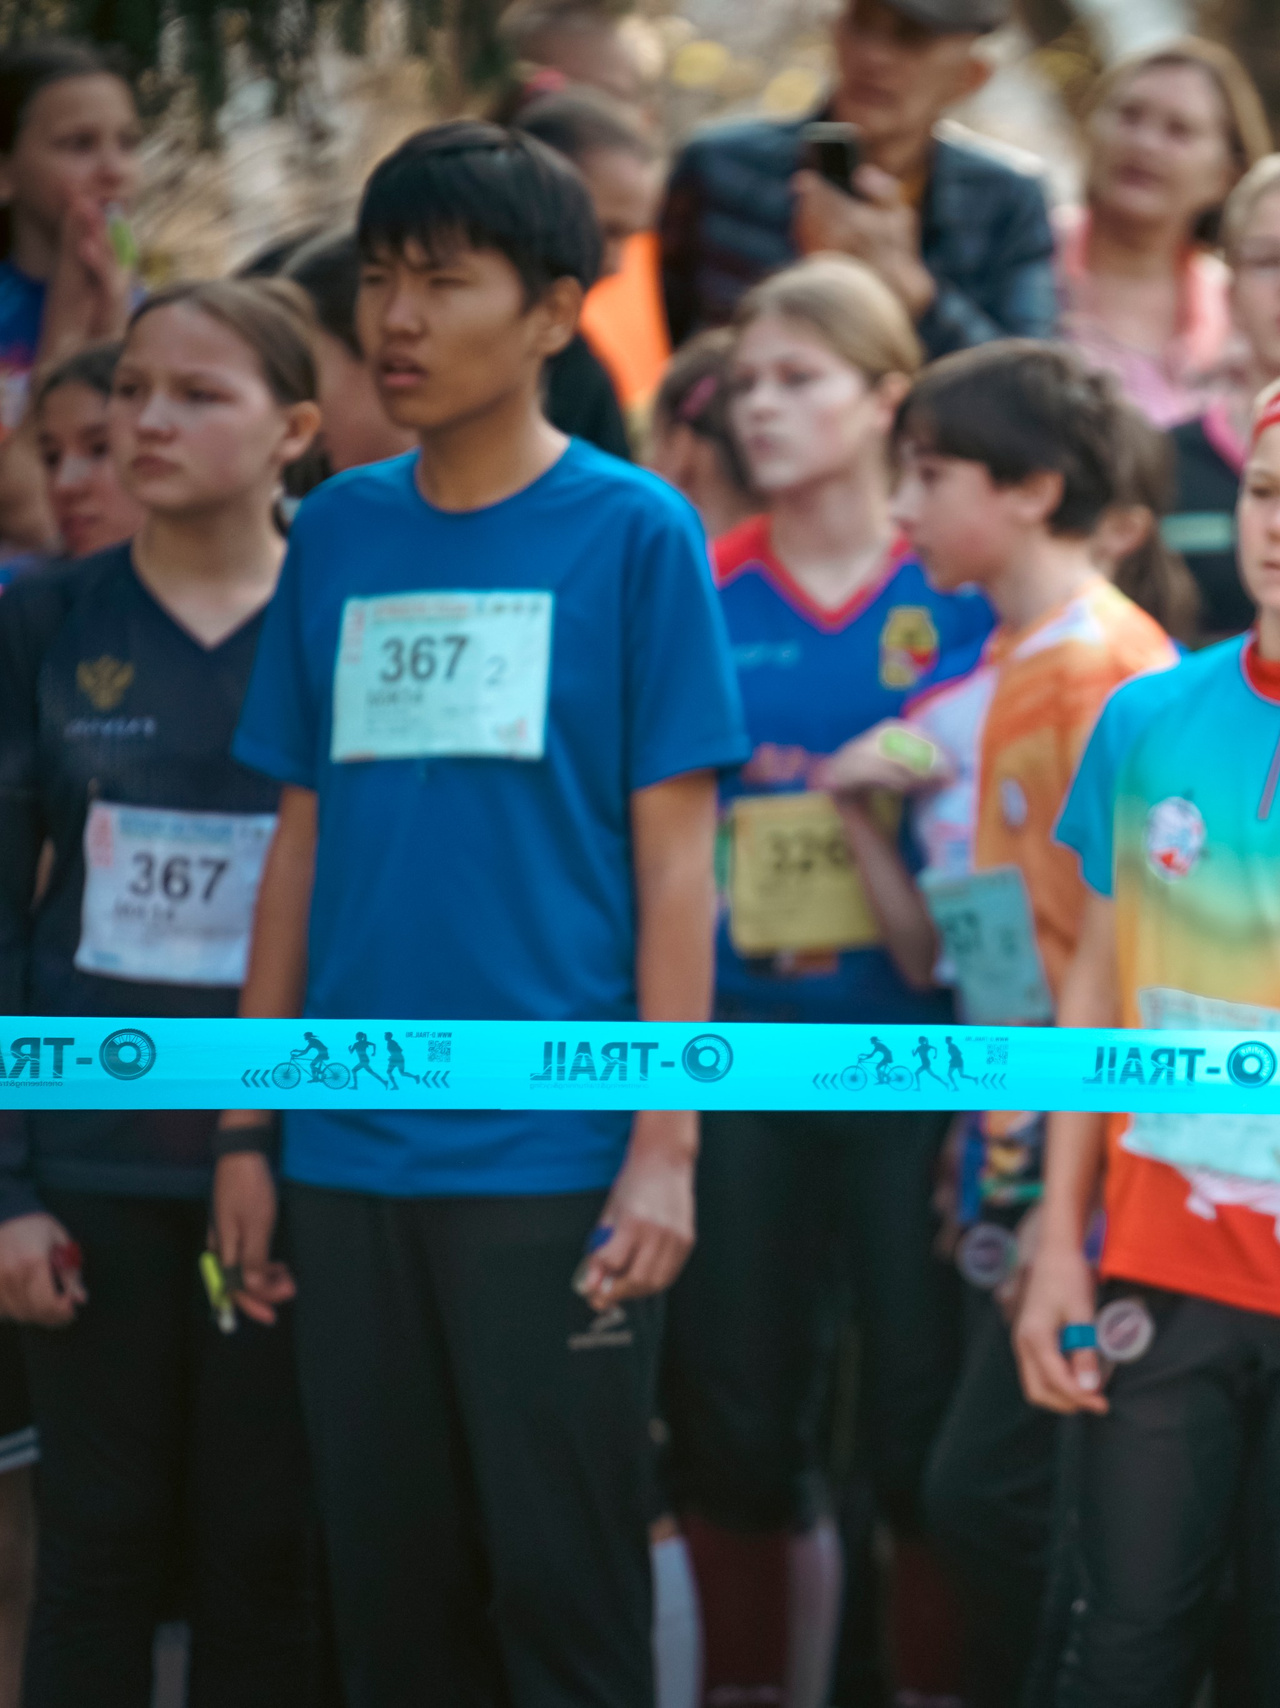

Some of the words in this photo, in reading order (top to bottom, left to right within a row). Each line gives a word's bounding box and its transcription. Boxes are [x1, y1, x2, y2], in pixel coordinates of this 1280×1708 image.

[380, 634, 470, 683] 367
[486, 656, 508, 685] 2
[128, 851, 232, 902] 367
